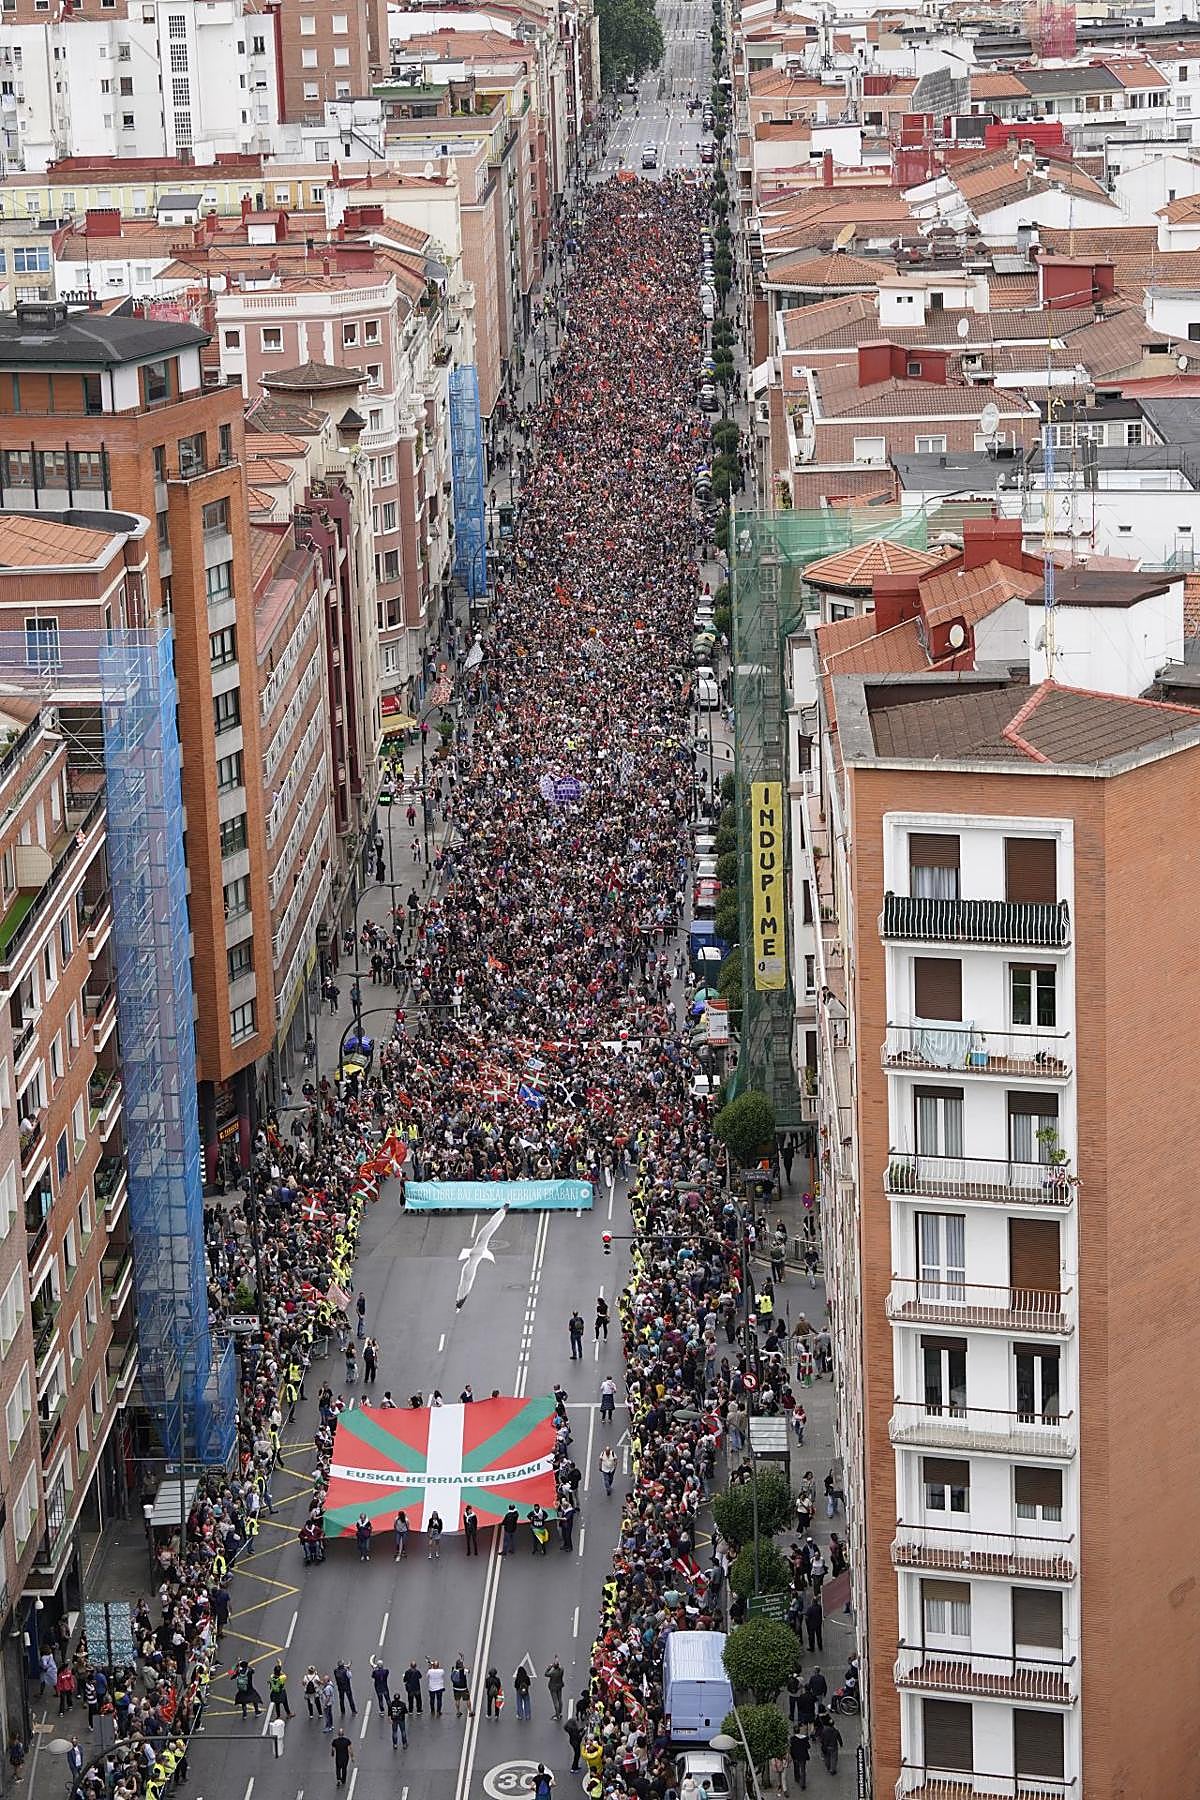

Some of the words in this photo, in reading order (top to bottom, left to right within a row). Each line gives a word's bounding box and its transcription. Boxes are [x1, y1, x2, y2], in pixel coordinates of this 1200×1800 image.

[759, 787, 778, 956] INDUPIME
[475, 1188, 505, 1201] EUSKAL
[507, 1187, 542, 1201] HERRIAK
[544, 1187, 579, 1201] ERABAKI
[346, 1469, 404, 1483] EUSKAL
[406, 1476, 474, 1484] HERRIAK
[476, 1463, 541, 1484] ERABAKI
